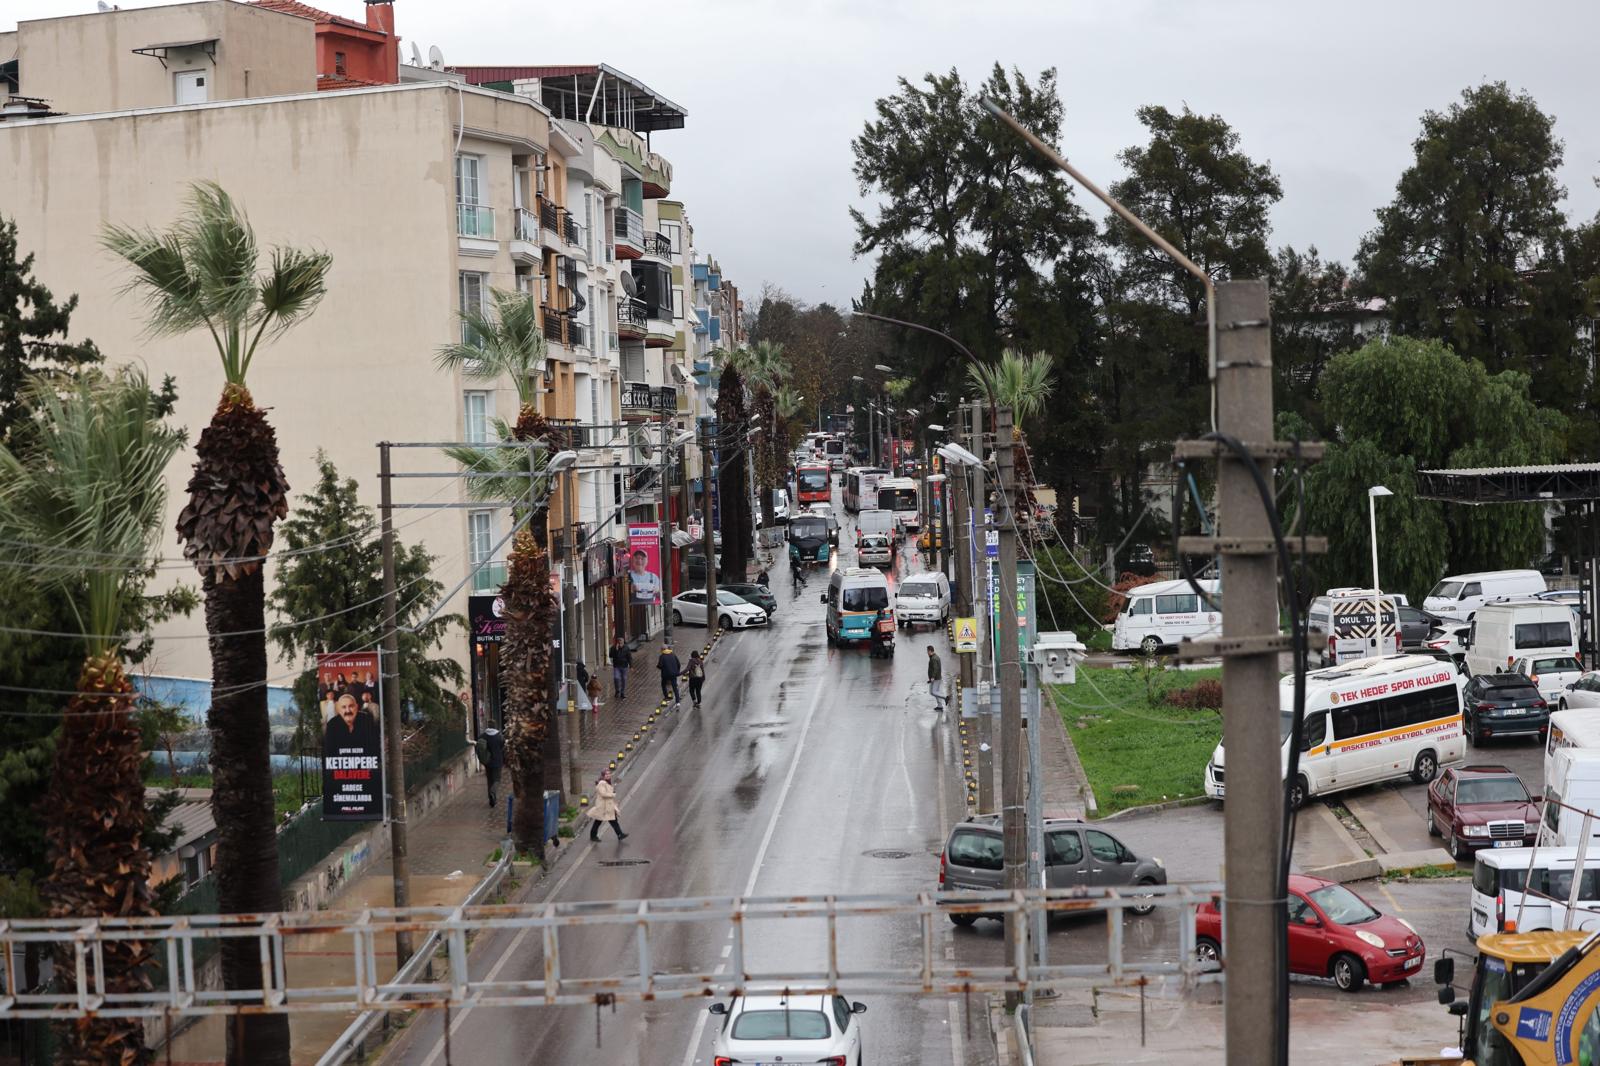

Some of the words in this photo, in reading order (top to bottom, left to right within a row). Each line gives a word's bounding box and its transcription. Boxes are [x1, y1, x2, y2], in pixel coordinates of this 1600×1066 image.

[1339, 616, 1360, 624] OKUL
[1340, 692, 1358, 702] TEK
[1360, 684, 1389, 698] HEDEF
[1391, 679, 1414, 692] SPOR
[1417, 671, 1451, 687] KULÜBÜ
[1341, 740, 1382, 753] BASKETBOL
[1389, 731, 1424, 743] VOLEYBOL
[1425, 722, 1458, 735] OKULLARI
[325, 756, 378, 769] KETENPERE
[333, 793, 372, 802] SİNEMALARDA
